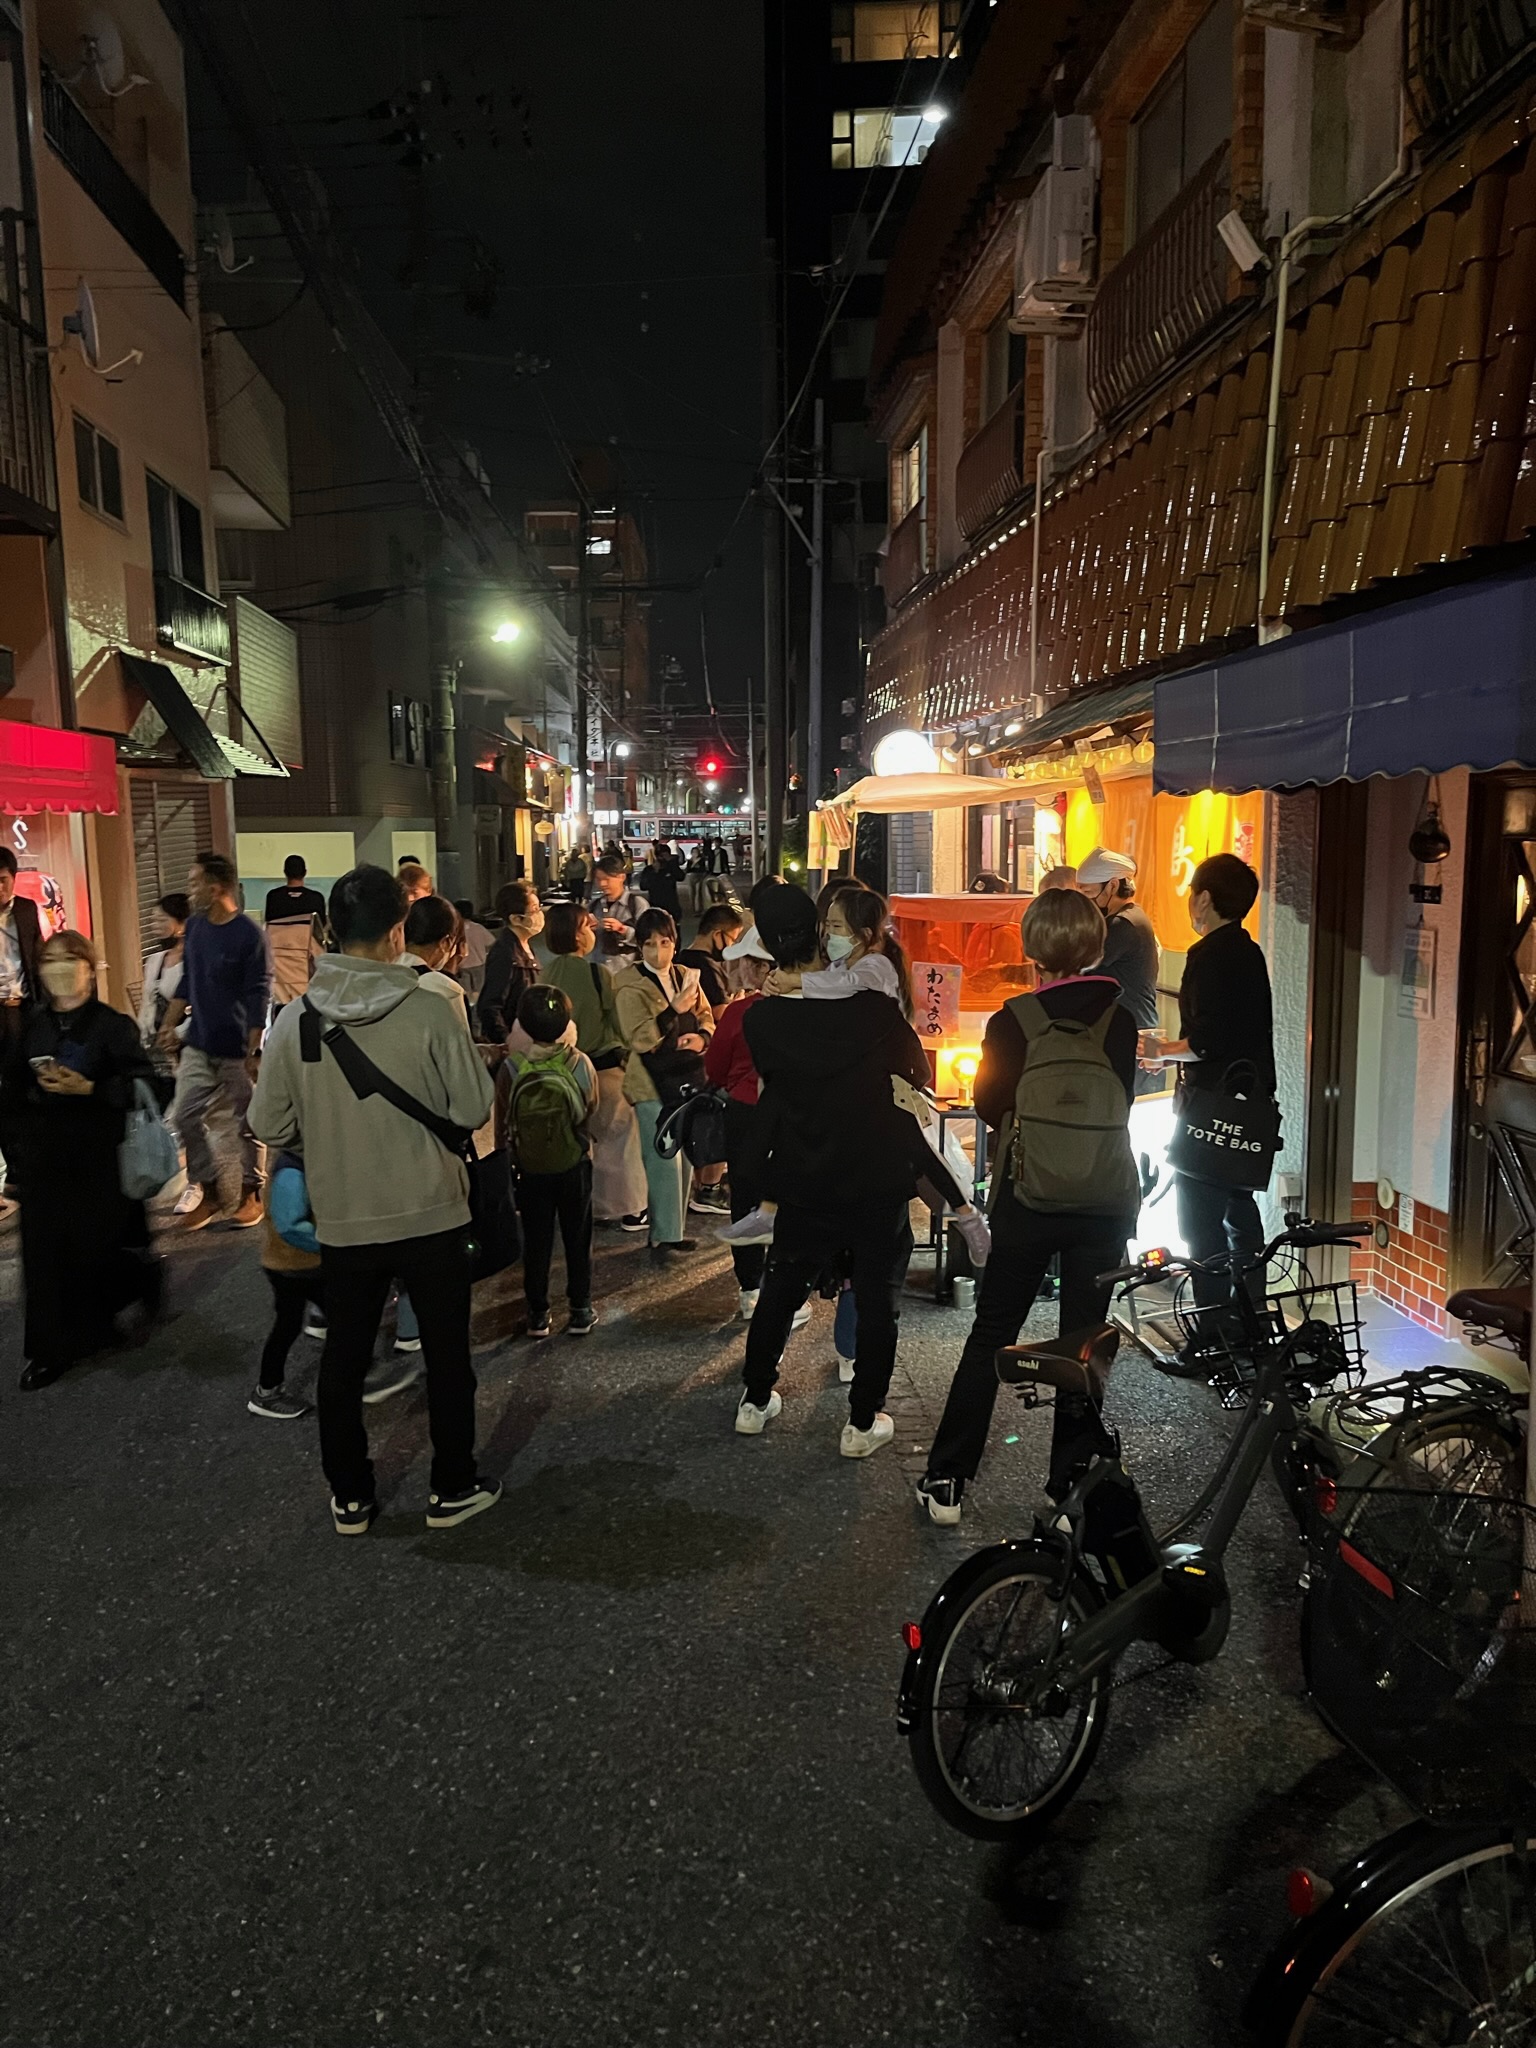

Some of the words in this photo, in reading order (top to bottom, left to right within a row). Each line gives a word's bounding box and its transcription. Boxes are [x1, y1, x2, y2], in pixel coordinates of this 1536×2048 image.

[926, 967, 944, 1036] わたあめ
[1186, 1124, 1227, 1147] TOTE
[1229, 1138, 1262, 1153] BAG
[1212, 1118, 1244, 1136] THE
